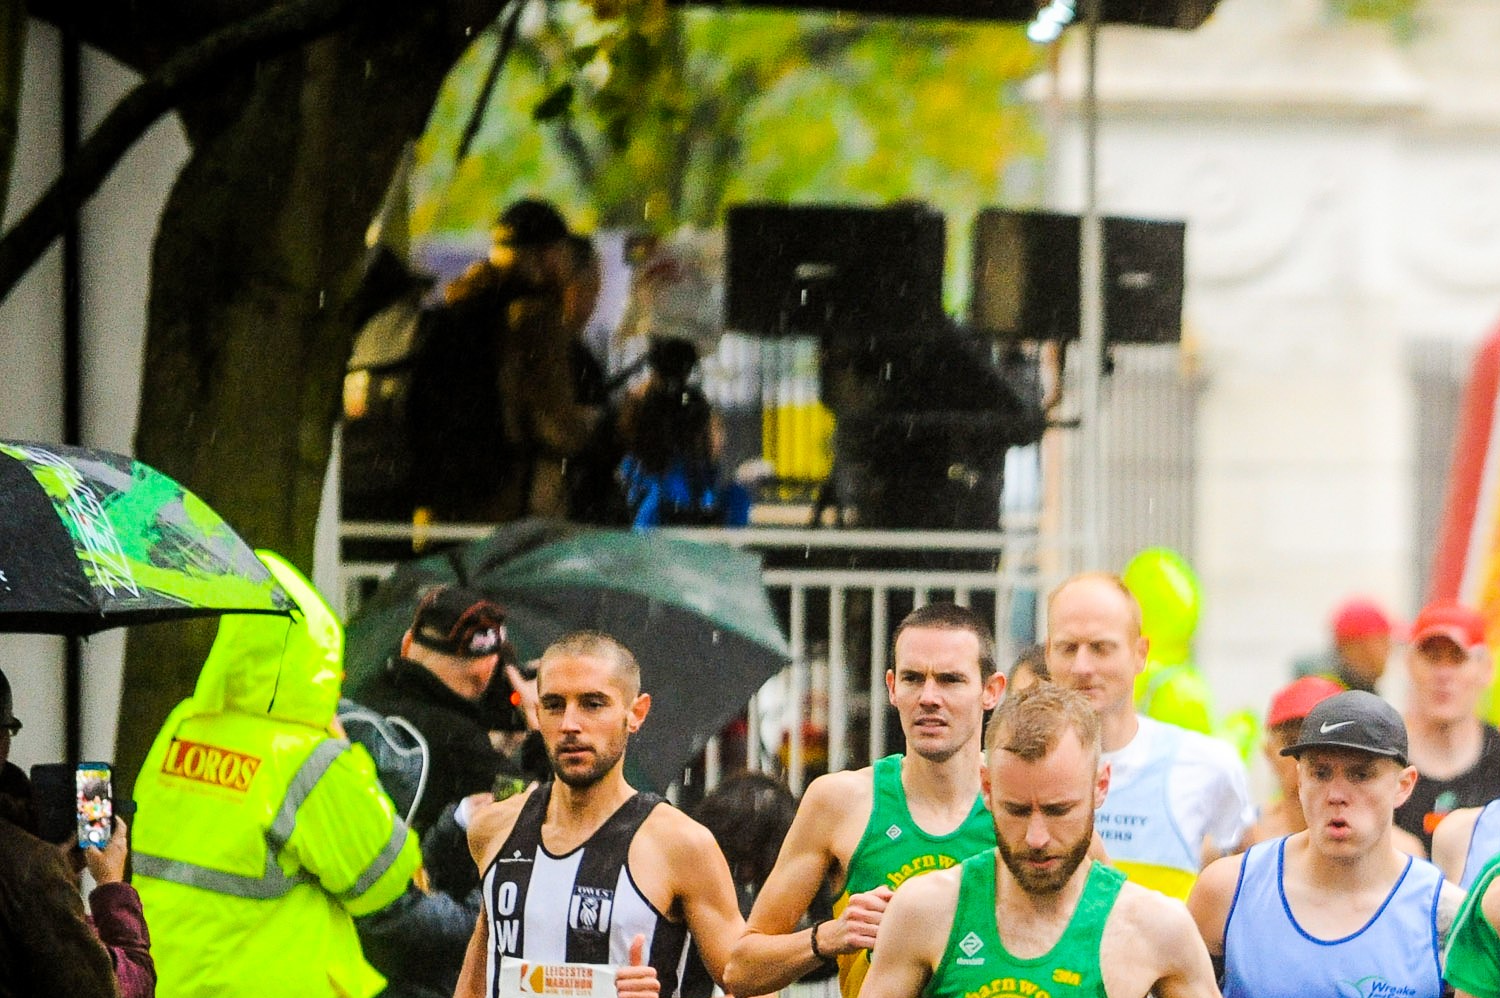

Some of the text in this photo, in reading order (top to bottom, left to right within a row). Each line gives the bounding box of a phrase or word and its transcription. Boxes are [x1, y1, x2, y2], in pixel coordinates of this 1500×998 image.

[165, 741, 256, 789] LOROS
[545, 966, 593, 977] LEICESTER
[545, 977, 593, 990] MARATHON
